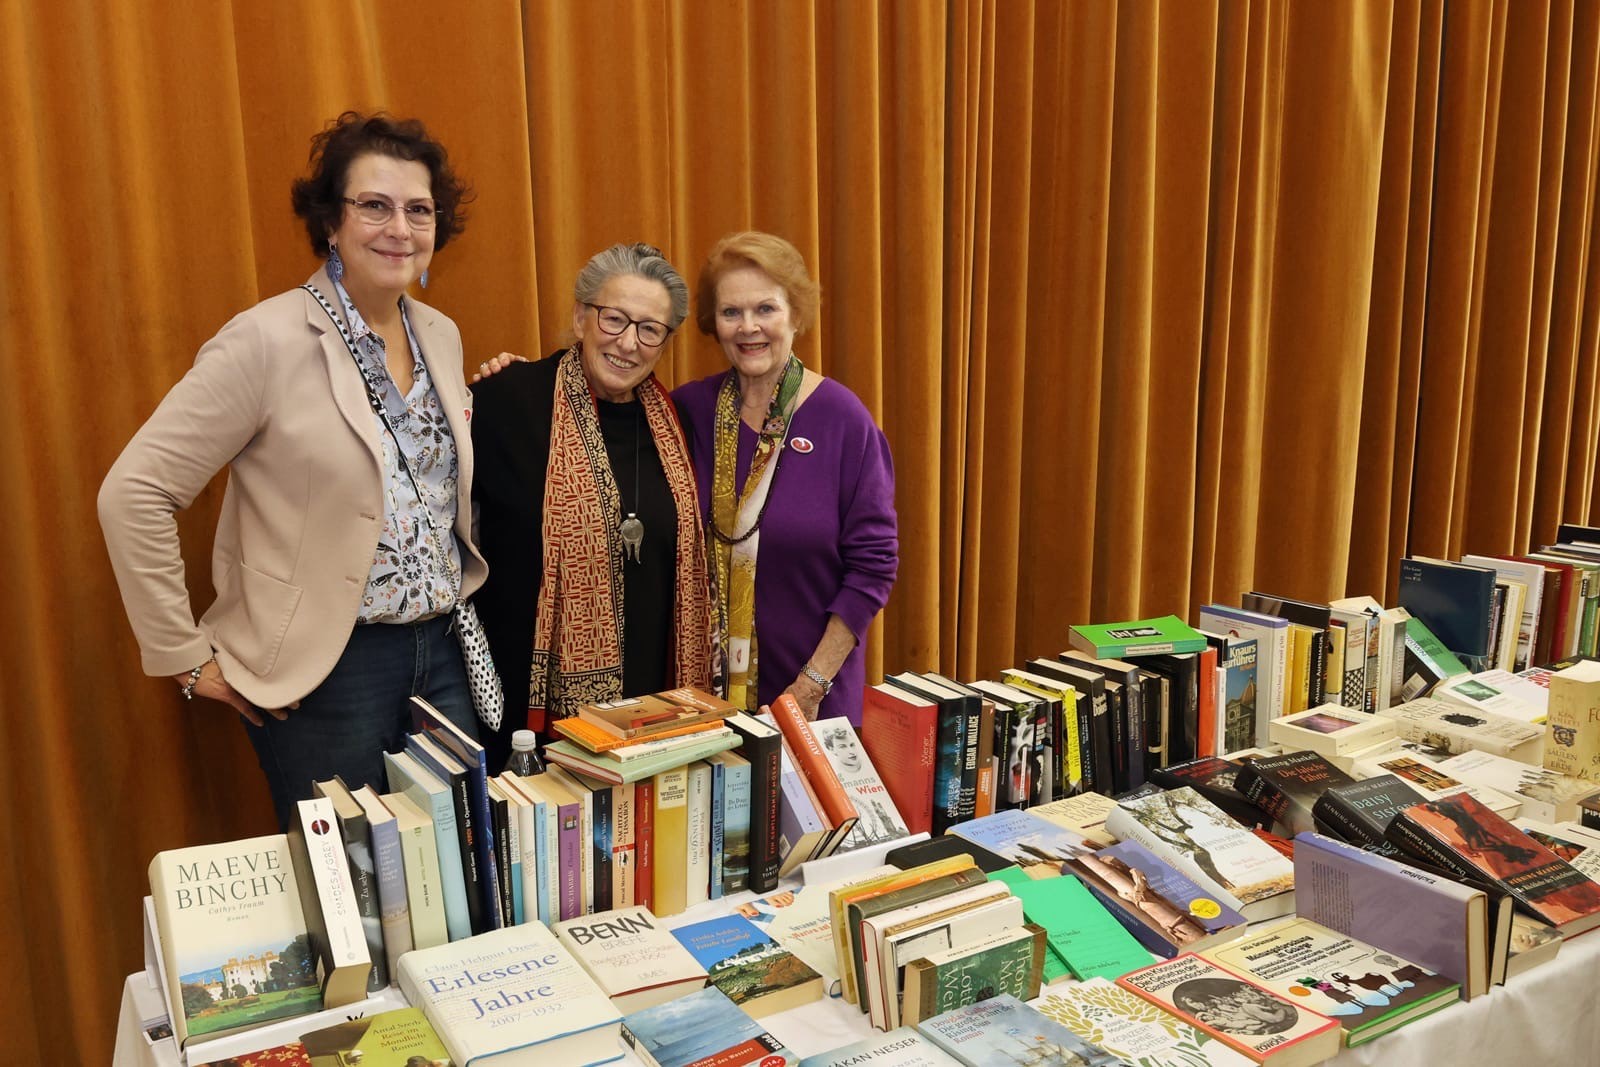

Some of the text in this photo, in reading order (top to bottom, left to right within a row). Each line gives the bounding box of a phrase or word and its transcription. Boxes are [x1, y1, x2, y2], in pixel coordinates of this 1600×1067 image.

[1229, 644, 1257, 658] Knaurs
[787, 700, 822, 757] AUFGEDECKT!
[966, 714, 980, 770] EDGAR WALLACE
[1254, 753, 1319, 771] Henning Mankell
[844, 776, 877, 789] manns
[1278, 768, 1297, 778] Die
[855, 784, 885, 796] Wien
[1341, 778, 1402, 796] HENNING MANKELL
[461, 780, 470, 818] Opernfreunde
[1324, 803, 1375, 844] HENNING MANKELL
[321, 840, 335, 864] GREY
[178, 849, 280, 884] MAEVE
[1507, 864, 1565, 885] HENNING MANKELL
[176, 872, 289, 910] BINCHY
[332, 873, 347, 916] SHADES
[239, 899, 265, 912] Traum
[568, 912, 655, 946] BENN
[600, 935, 648, 951] BRIEFE
[425, 962, 458, 974] Claus
[462, 951, 504, 967] Helmut
[1013, 941, 1033, 1000] Thom
[427, 952, 560, 994] Erlesene
[999, 959, 1013, 991] Ma
[1126, 968, 1152, 986] Pierre
[1134, 978, 1150, 992] Die
[1184, 964, 1200, 976] der
[943, 967, 959, 1011] Wei
[960, 963, 976, 1007] Lott
[469, 983, 555, 1020] Jahre
[381, 1030, 403, 1040] Reise
[939, 1023, 955, 1035] Die
[945, 1018, 992, 1040] Rising Sun
[952, 1029, 985, 1044] Roman
[1109, 1024, 1152, 1044] KONZERT
[1128, 1032, 1154, 1046] OHNE
[379, 1032, 427, 1048] Mondlicht
[391, 1040, 425, 1053] Roman
[762, 1034, 783, 1050] PIPER
[873, 1037, 920, 1056] NESSER
[1255, 1034, 1288, 1052] rowohlt
